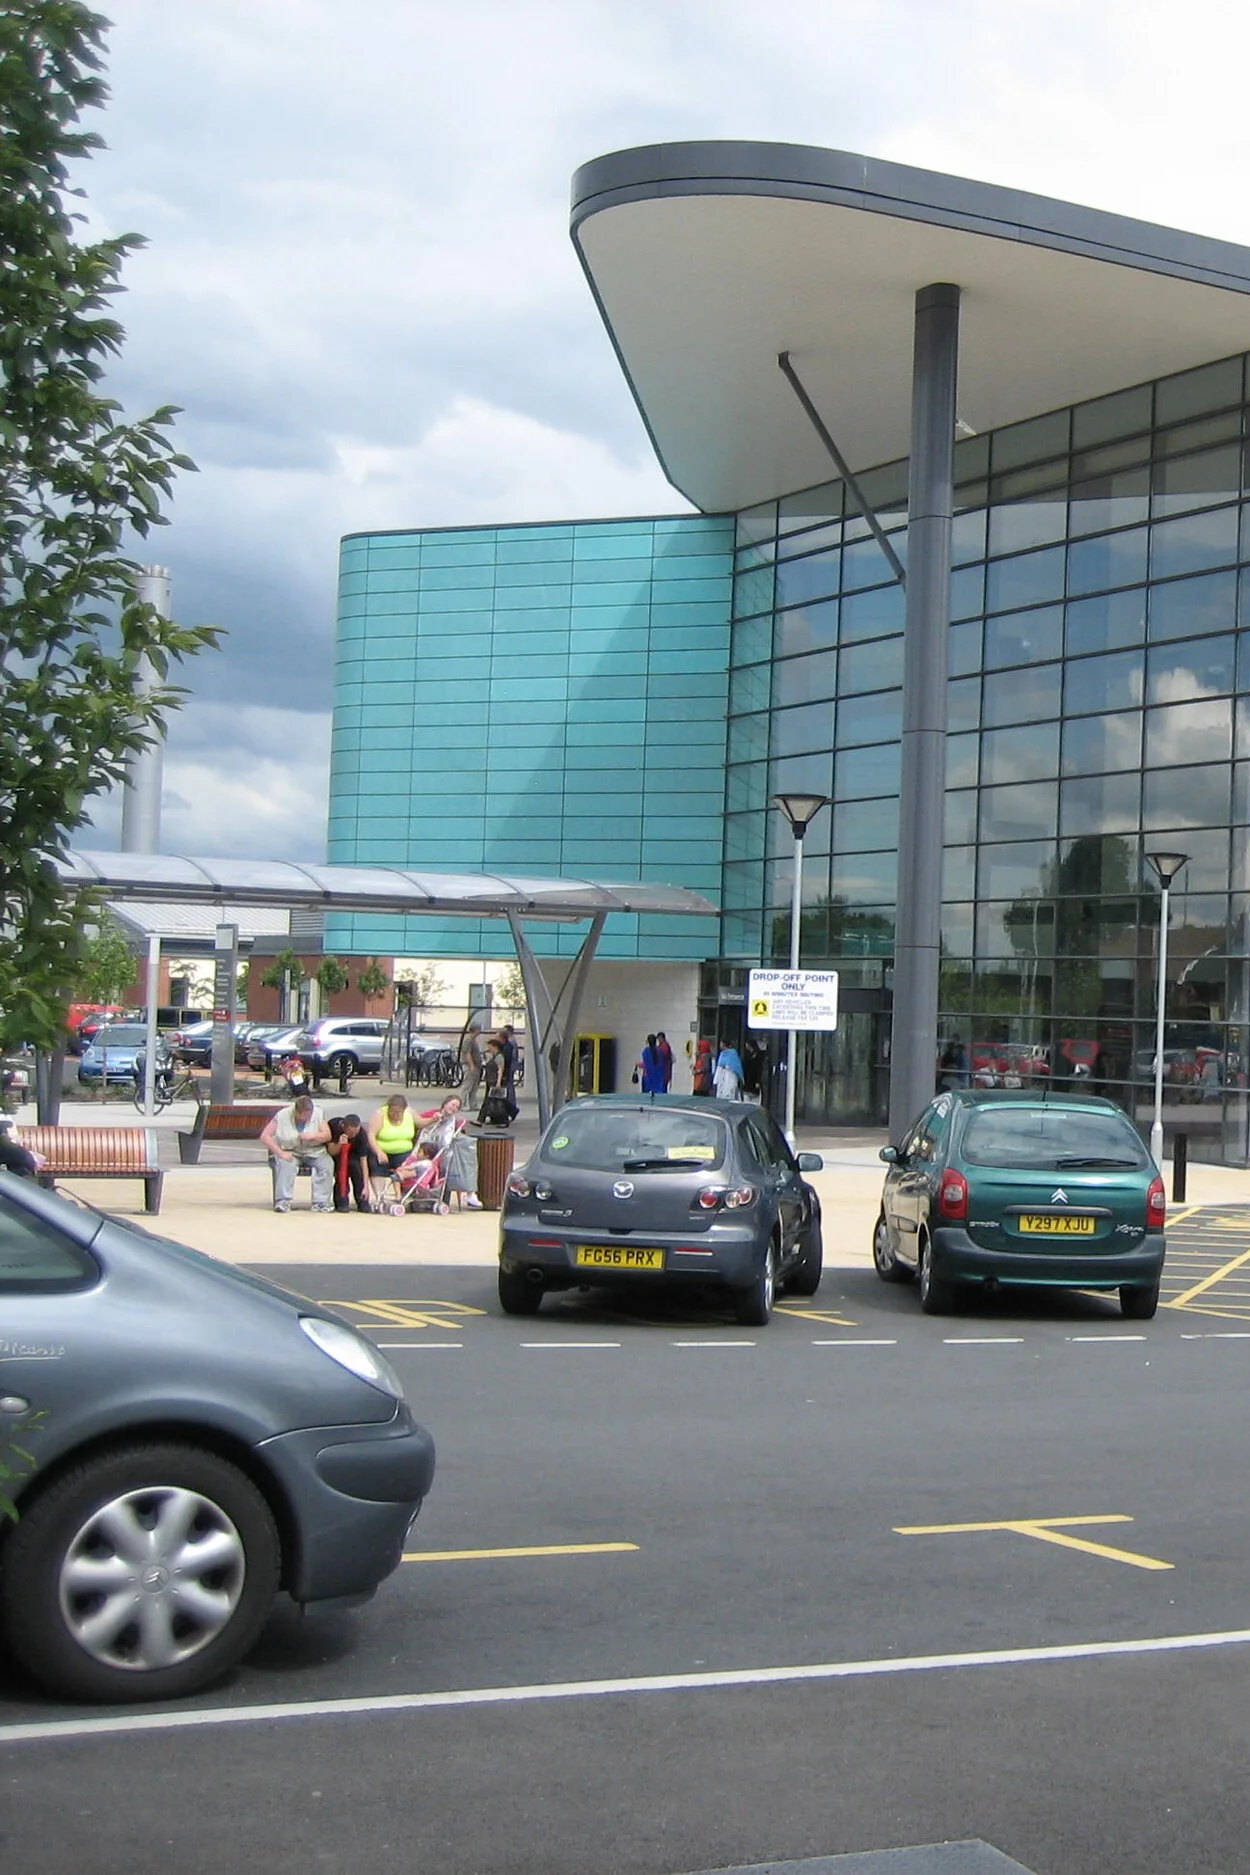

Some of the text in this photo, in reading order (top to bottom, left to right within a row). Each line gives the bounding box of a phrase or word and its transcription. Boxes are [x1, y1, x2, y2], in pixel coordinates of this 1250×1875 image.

[752, 973, 835, 983] DROP-OFF POINT
[781, 983, 806, 991] ONLY
[1026, 1216, 1090, 1231] Y297 XJU
[583, 1249, 656, 1266] FG56 PRX
